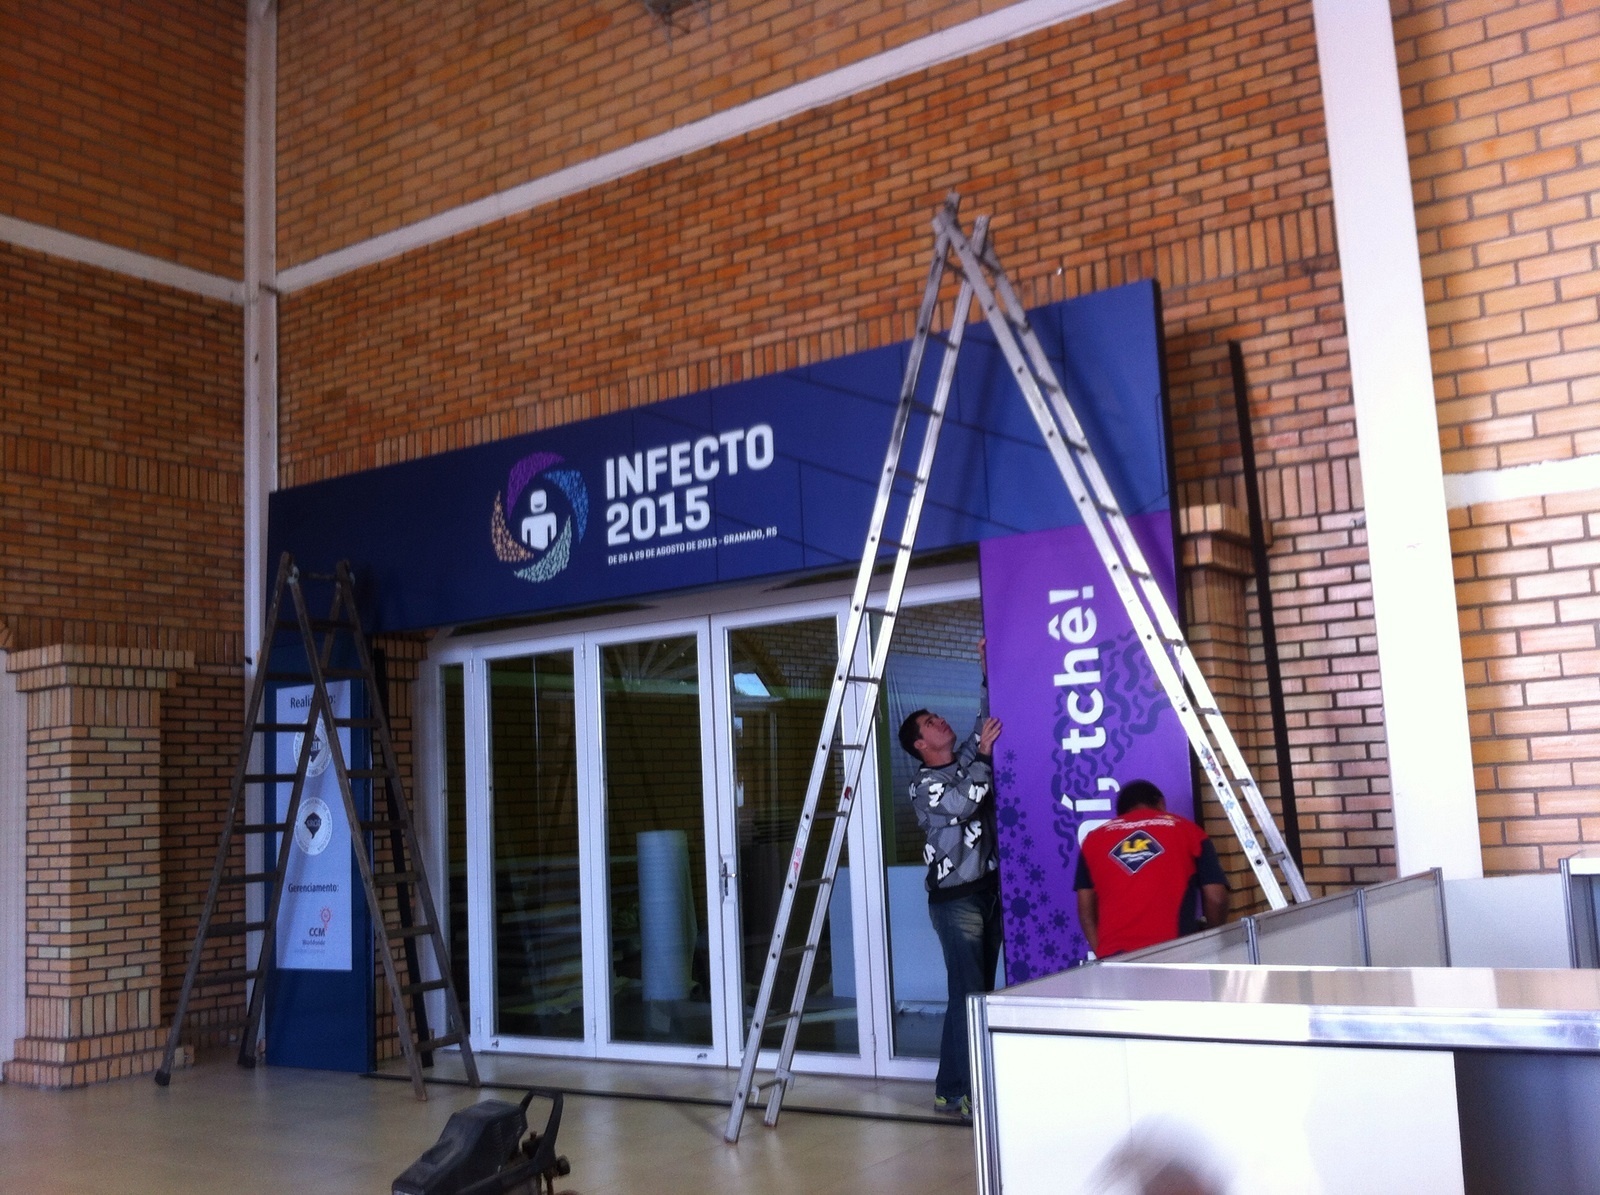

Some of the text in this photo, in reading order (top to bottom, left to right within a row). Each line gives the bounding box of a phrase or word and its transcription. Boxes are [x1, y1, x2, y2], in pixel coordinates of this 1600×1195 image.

[605, 423, 775, 500] INFECTO
[606, 485, 711, 547] 2015
[608, 555, 618, 566] DE
[629, 551, 635, 562] A
[645, 548, 656, 559] DE
[656, 543, 686, 557] AGOSTO
[686, 540, 697, 551] DE
[697, 536, 718, 550] 2015
[723, 528, 766, 545] GRAMADO,
[1048, 585, 1107, 754] tchê!
[290, 694, 336, 709] Realio:
[288, 882, 339, 893] Gerenciamento:
[309, 927, 326, 937] CCM
